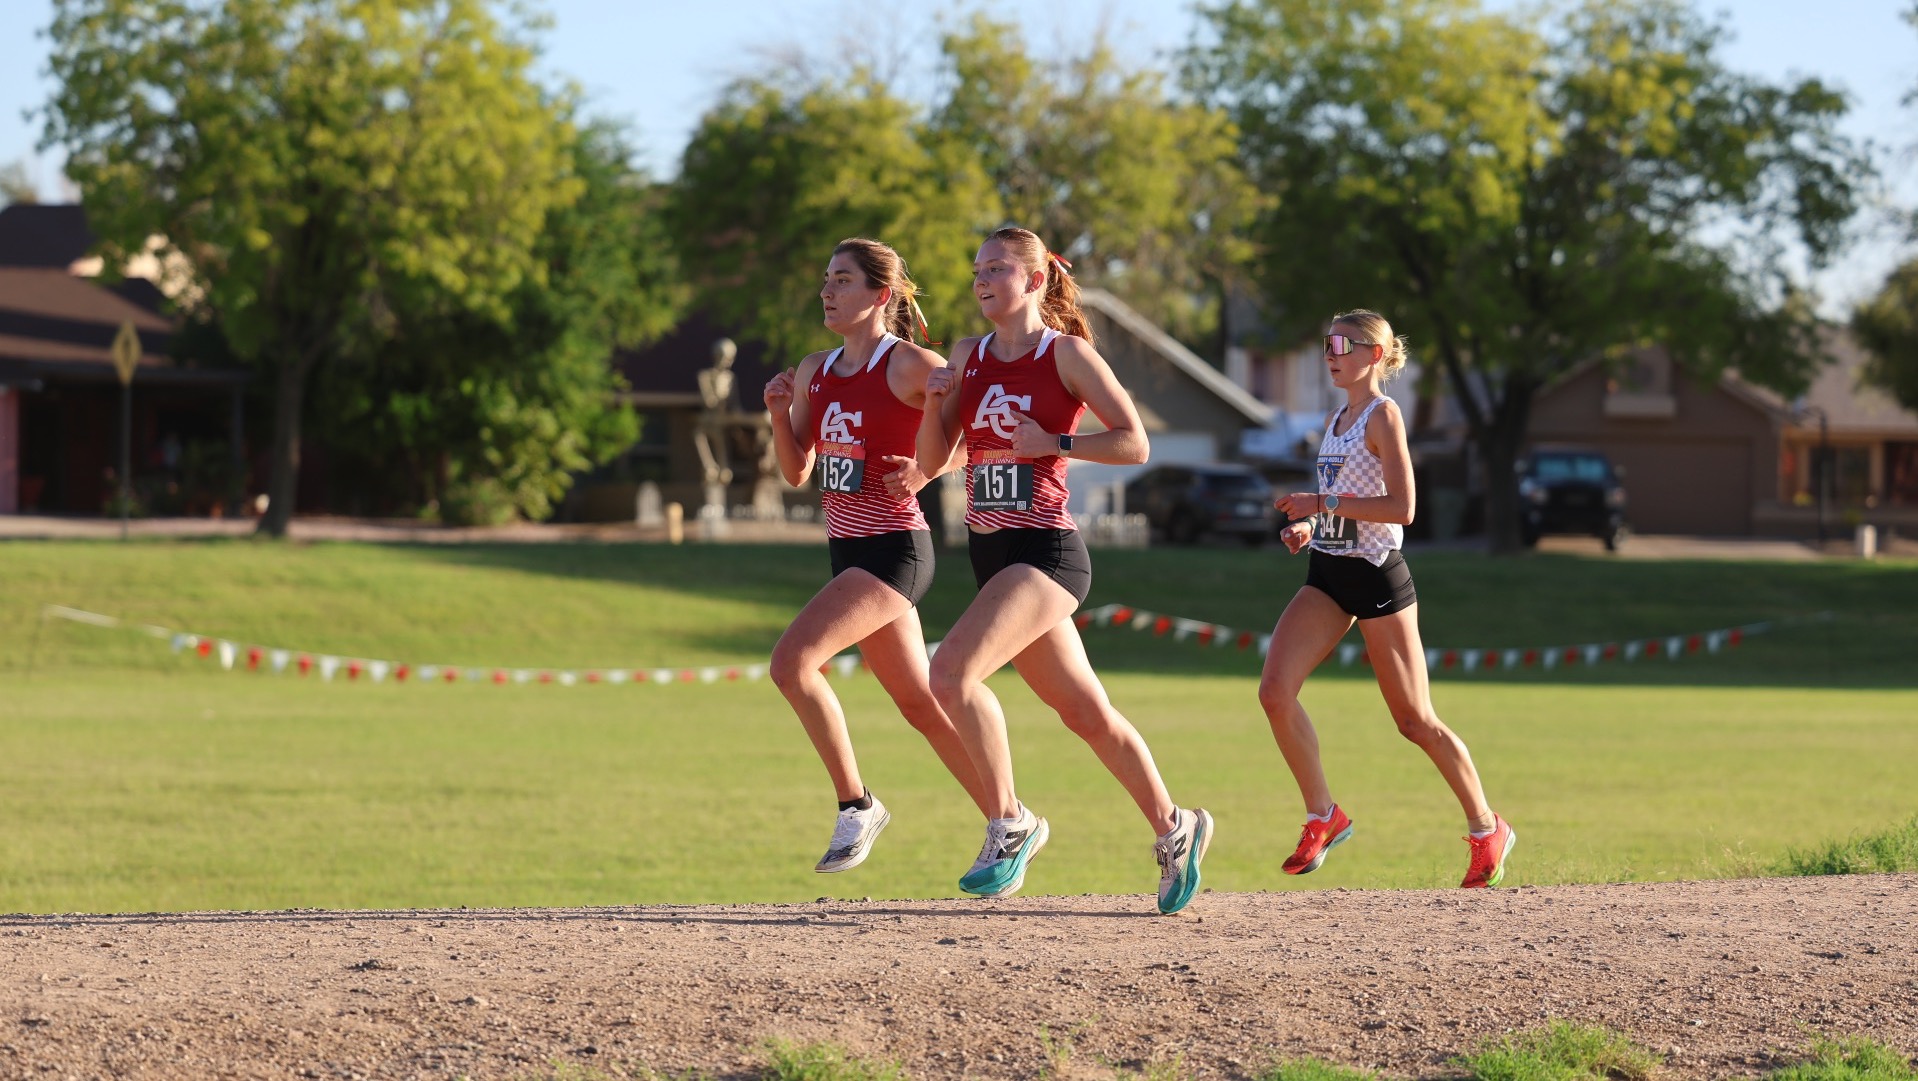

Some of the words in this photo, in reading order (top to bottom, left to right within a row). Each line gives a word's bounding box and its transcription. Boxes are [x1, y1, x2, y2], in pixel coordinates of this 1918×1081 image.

[820, 401, 862, 445] AC
[971, 384, 1031, 439] AC
[822, 455, 854, 491] 152
[981, 465, 1018, 499] 151
